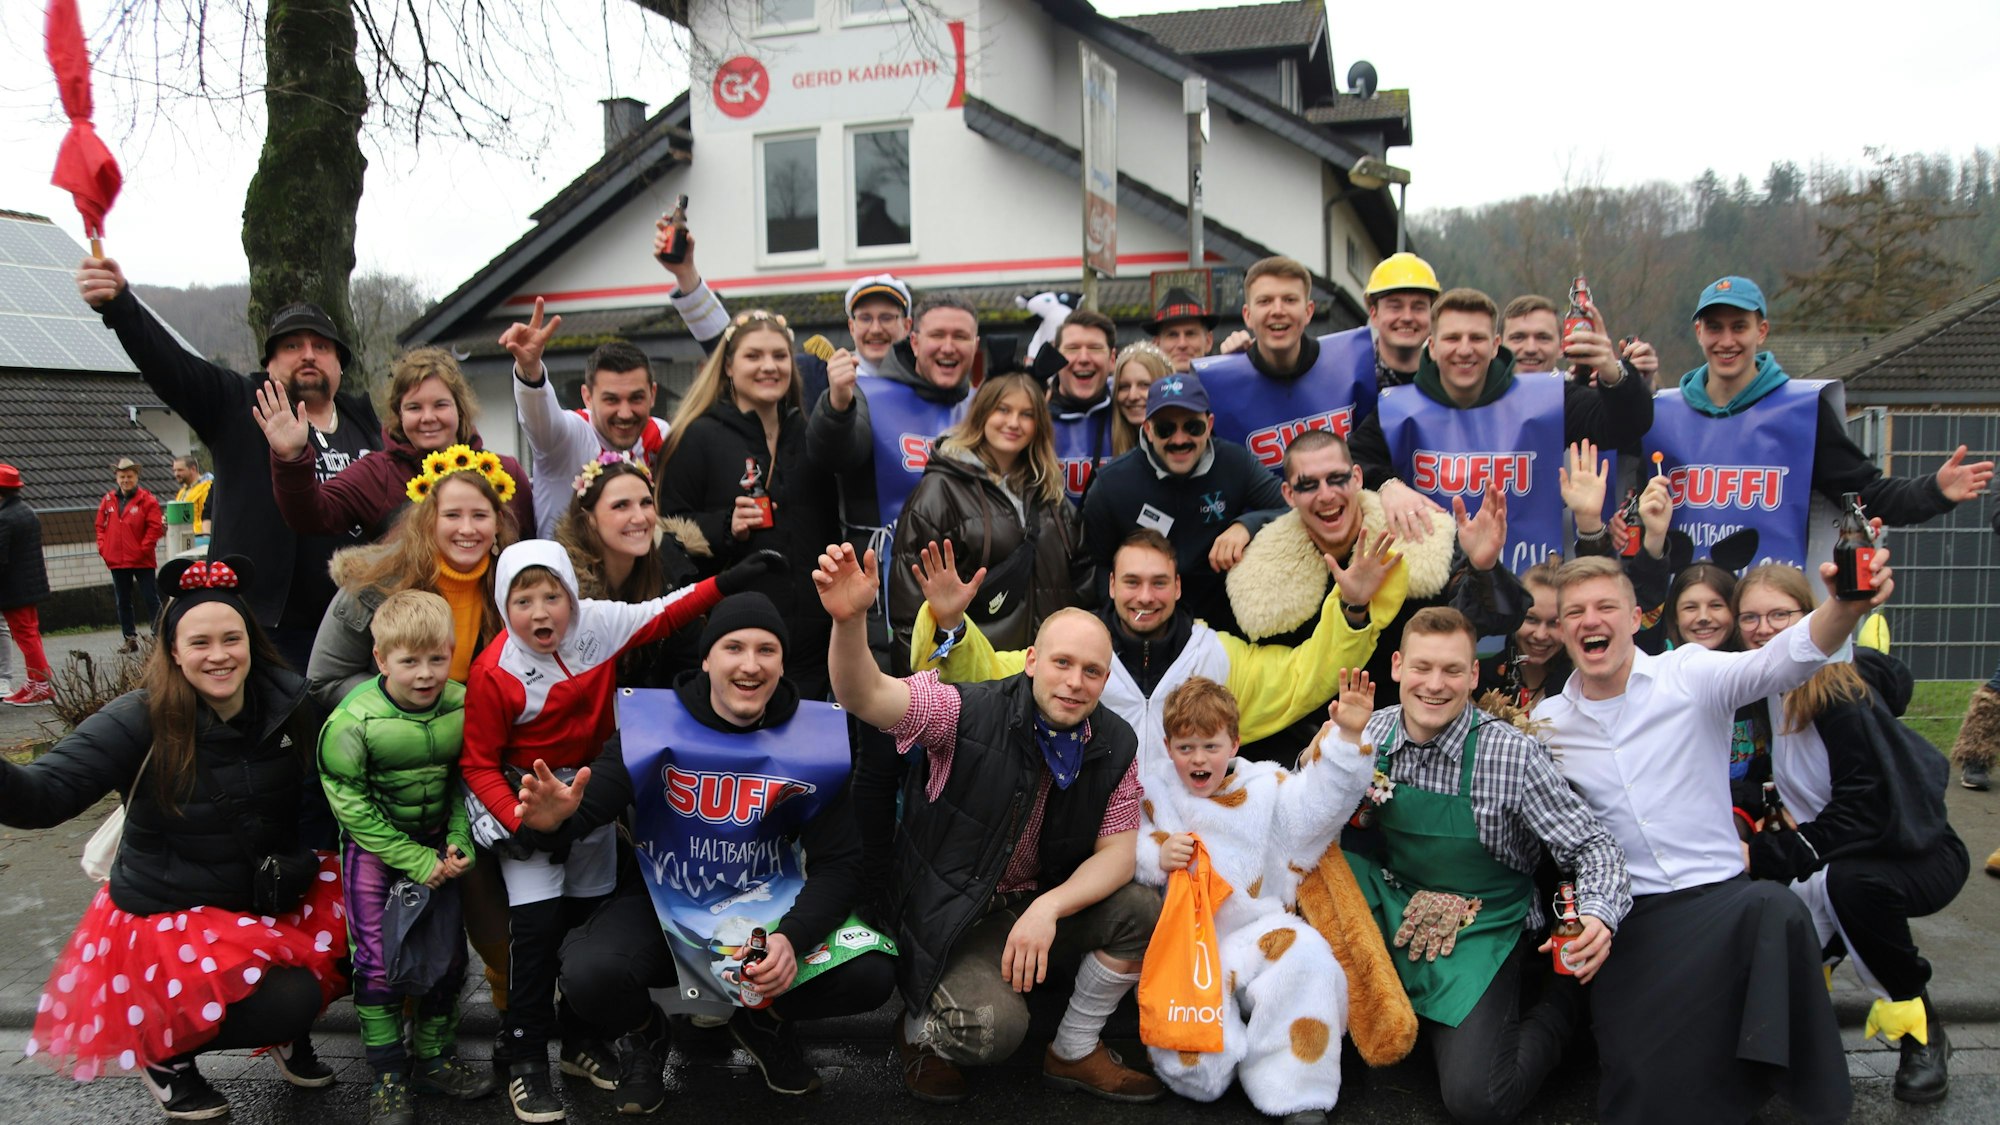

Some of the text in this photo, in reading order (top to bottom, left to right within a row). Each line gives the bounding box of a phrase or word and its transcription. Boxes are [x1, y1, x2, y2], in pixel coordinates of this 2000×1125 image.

[719, 72, 761, 103] GK
[792, 59, 938, 89] GERD KARNATH
[1413, 452, 1530, 495] SUFFI
[1670, 467, 1783, 509] SUFFI
[526, 673, 544, 686] erima
